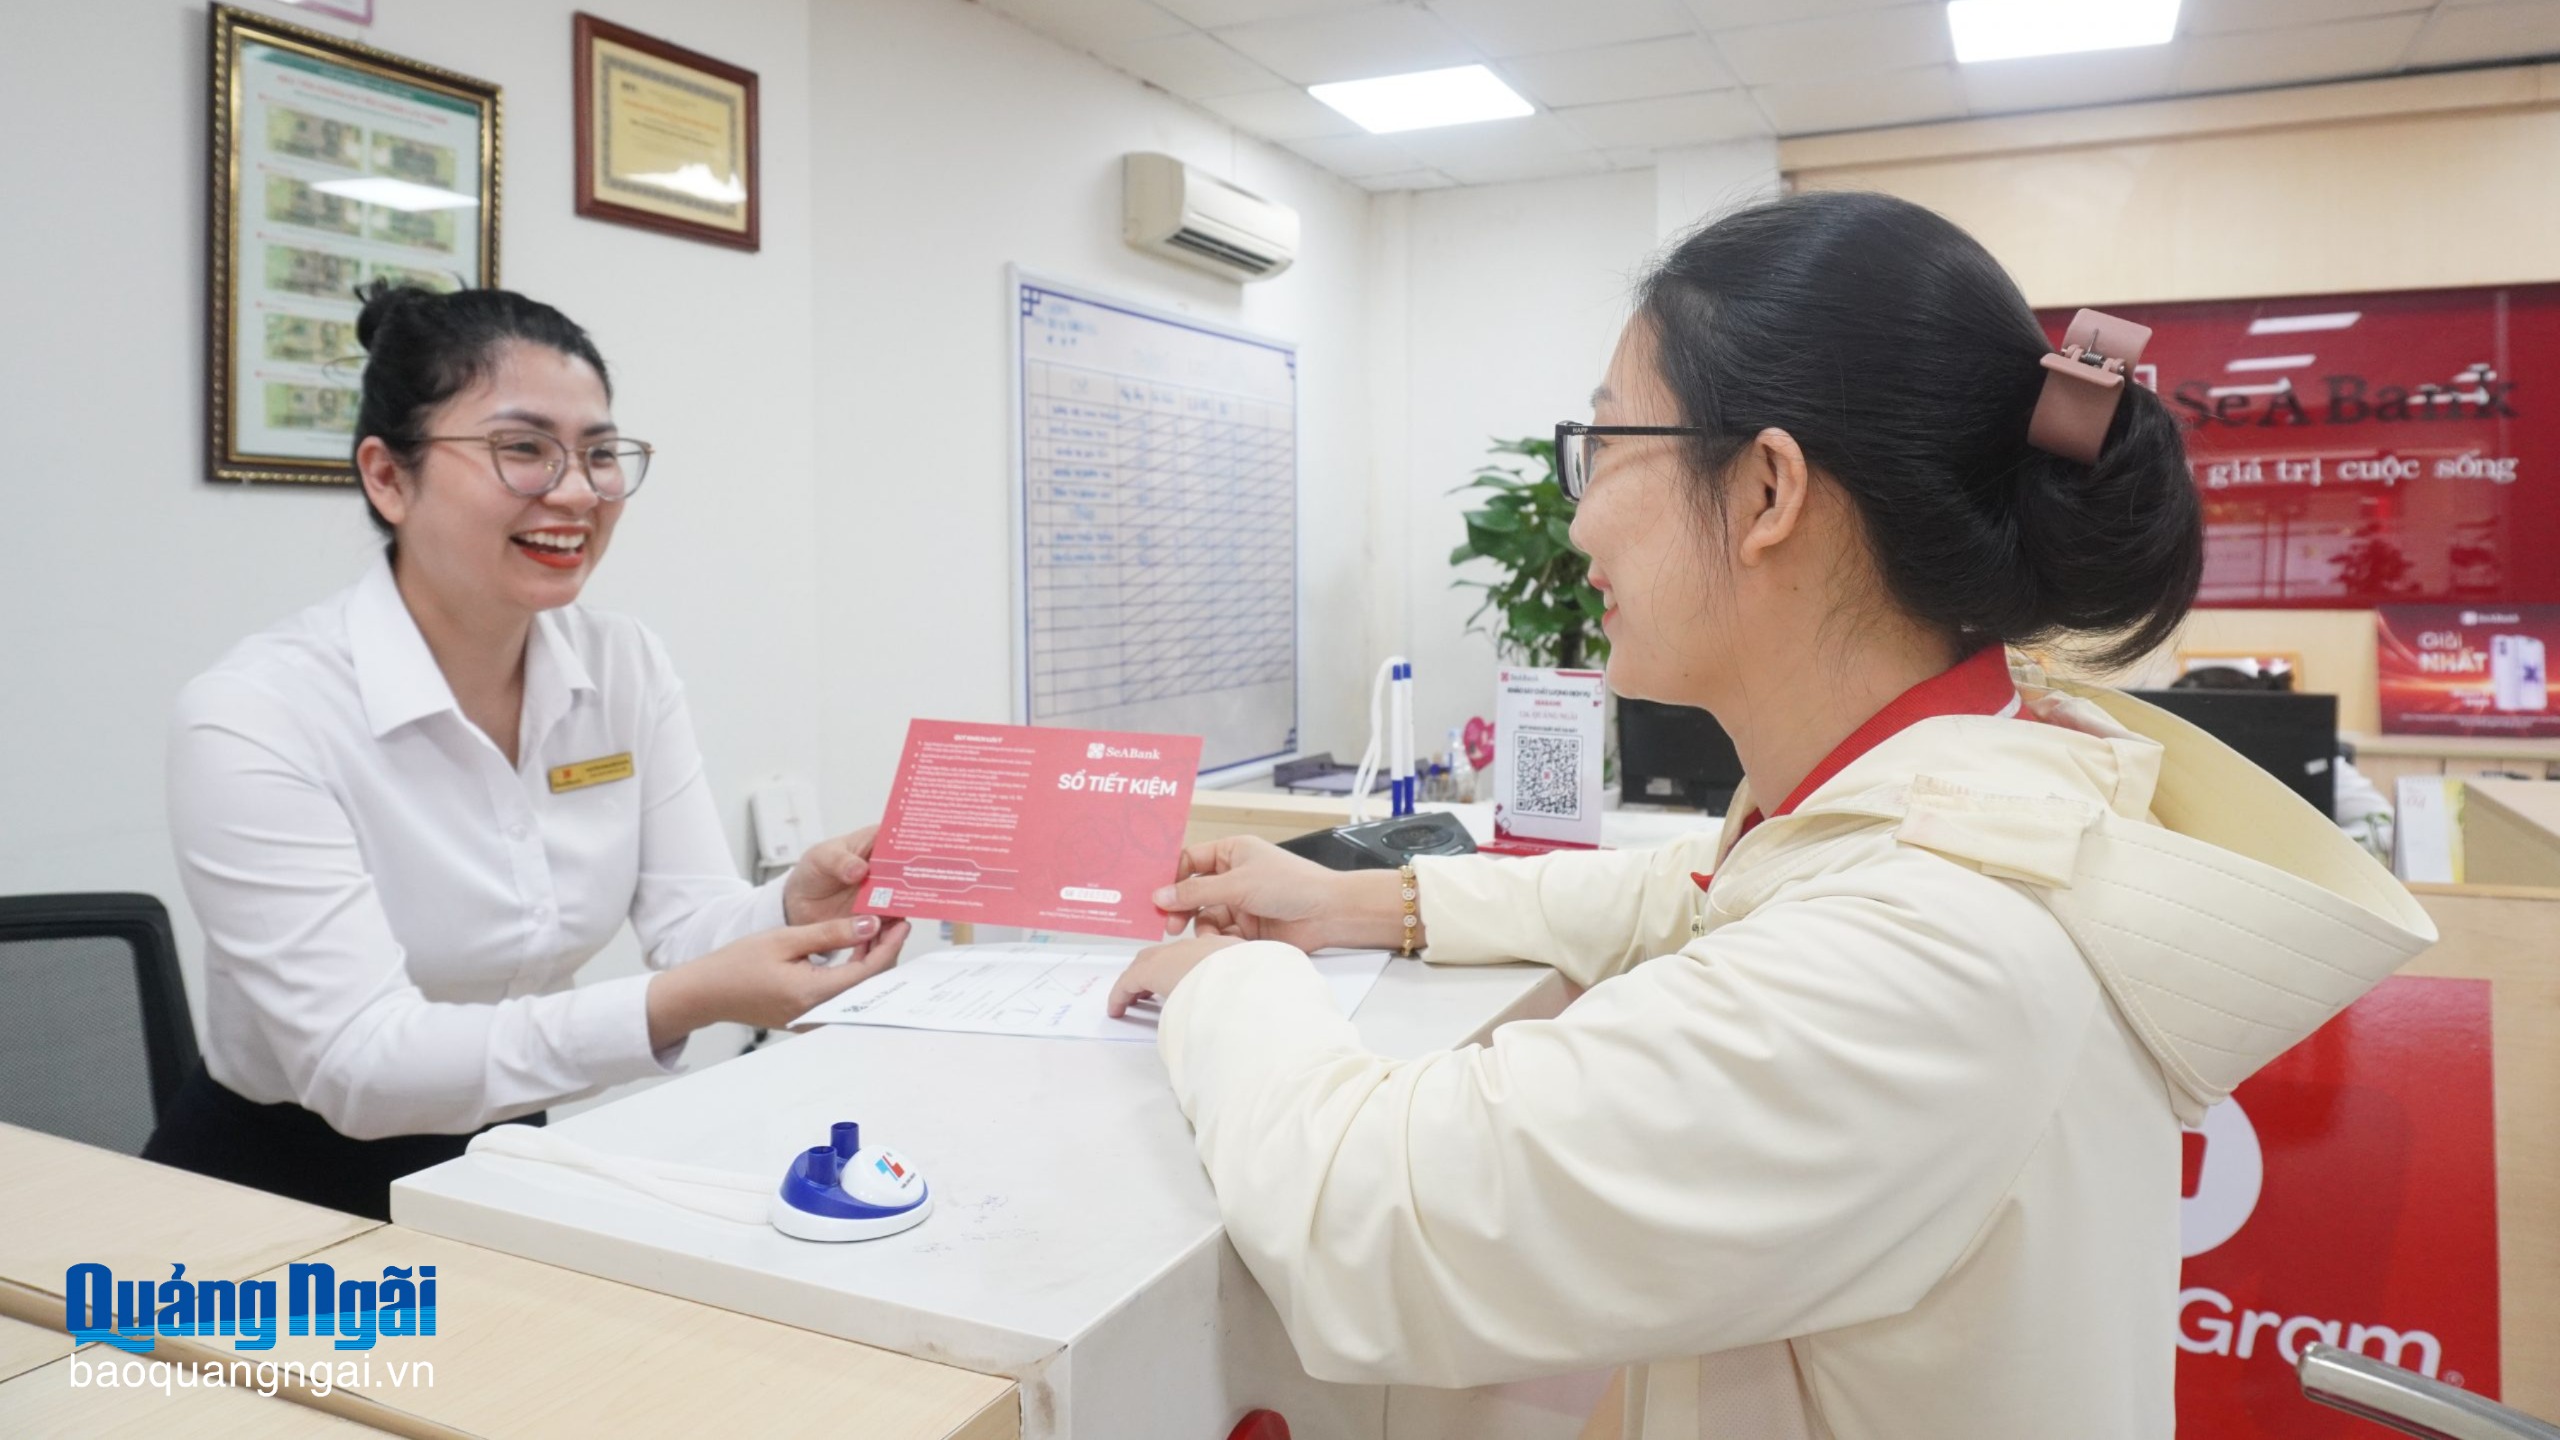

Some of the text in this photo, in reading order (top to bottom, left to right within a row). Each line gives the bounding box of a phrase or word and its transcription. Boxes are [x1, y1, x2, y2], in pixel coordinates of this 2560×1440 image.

[2207, 448, 2520, 488] giá trị cuộc sống
[2418, 646, 2488, 672] NHẤT
[1106, 746, 1161, 760] SeABank
[1057, 769, 1178, 799] SỔ TIẾT KIỆM
